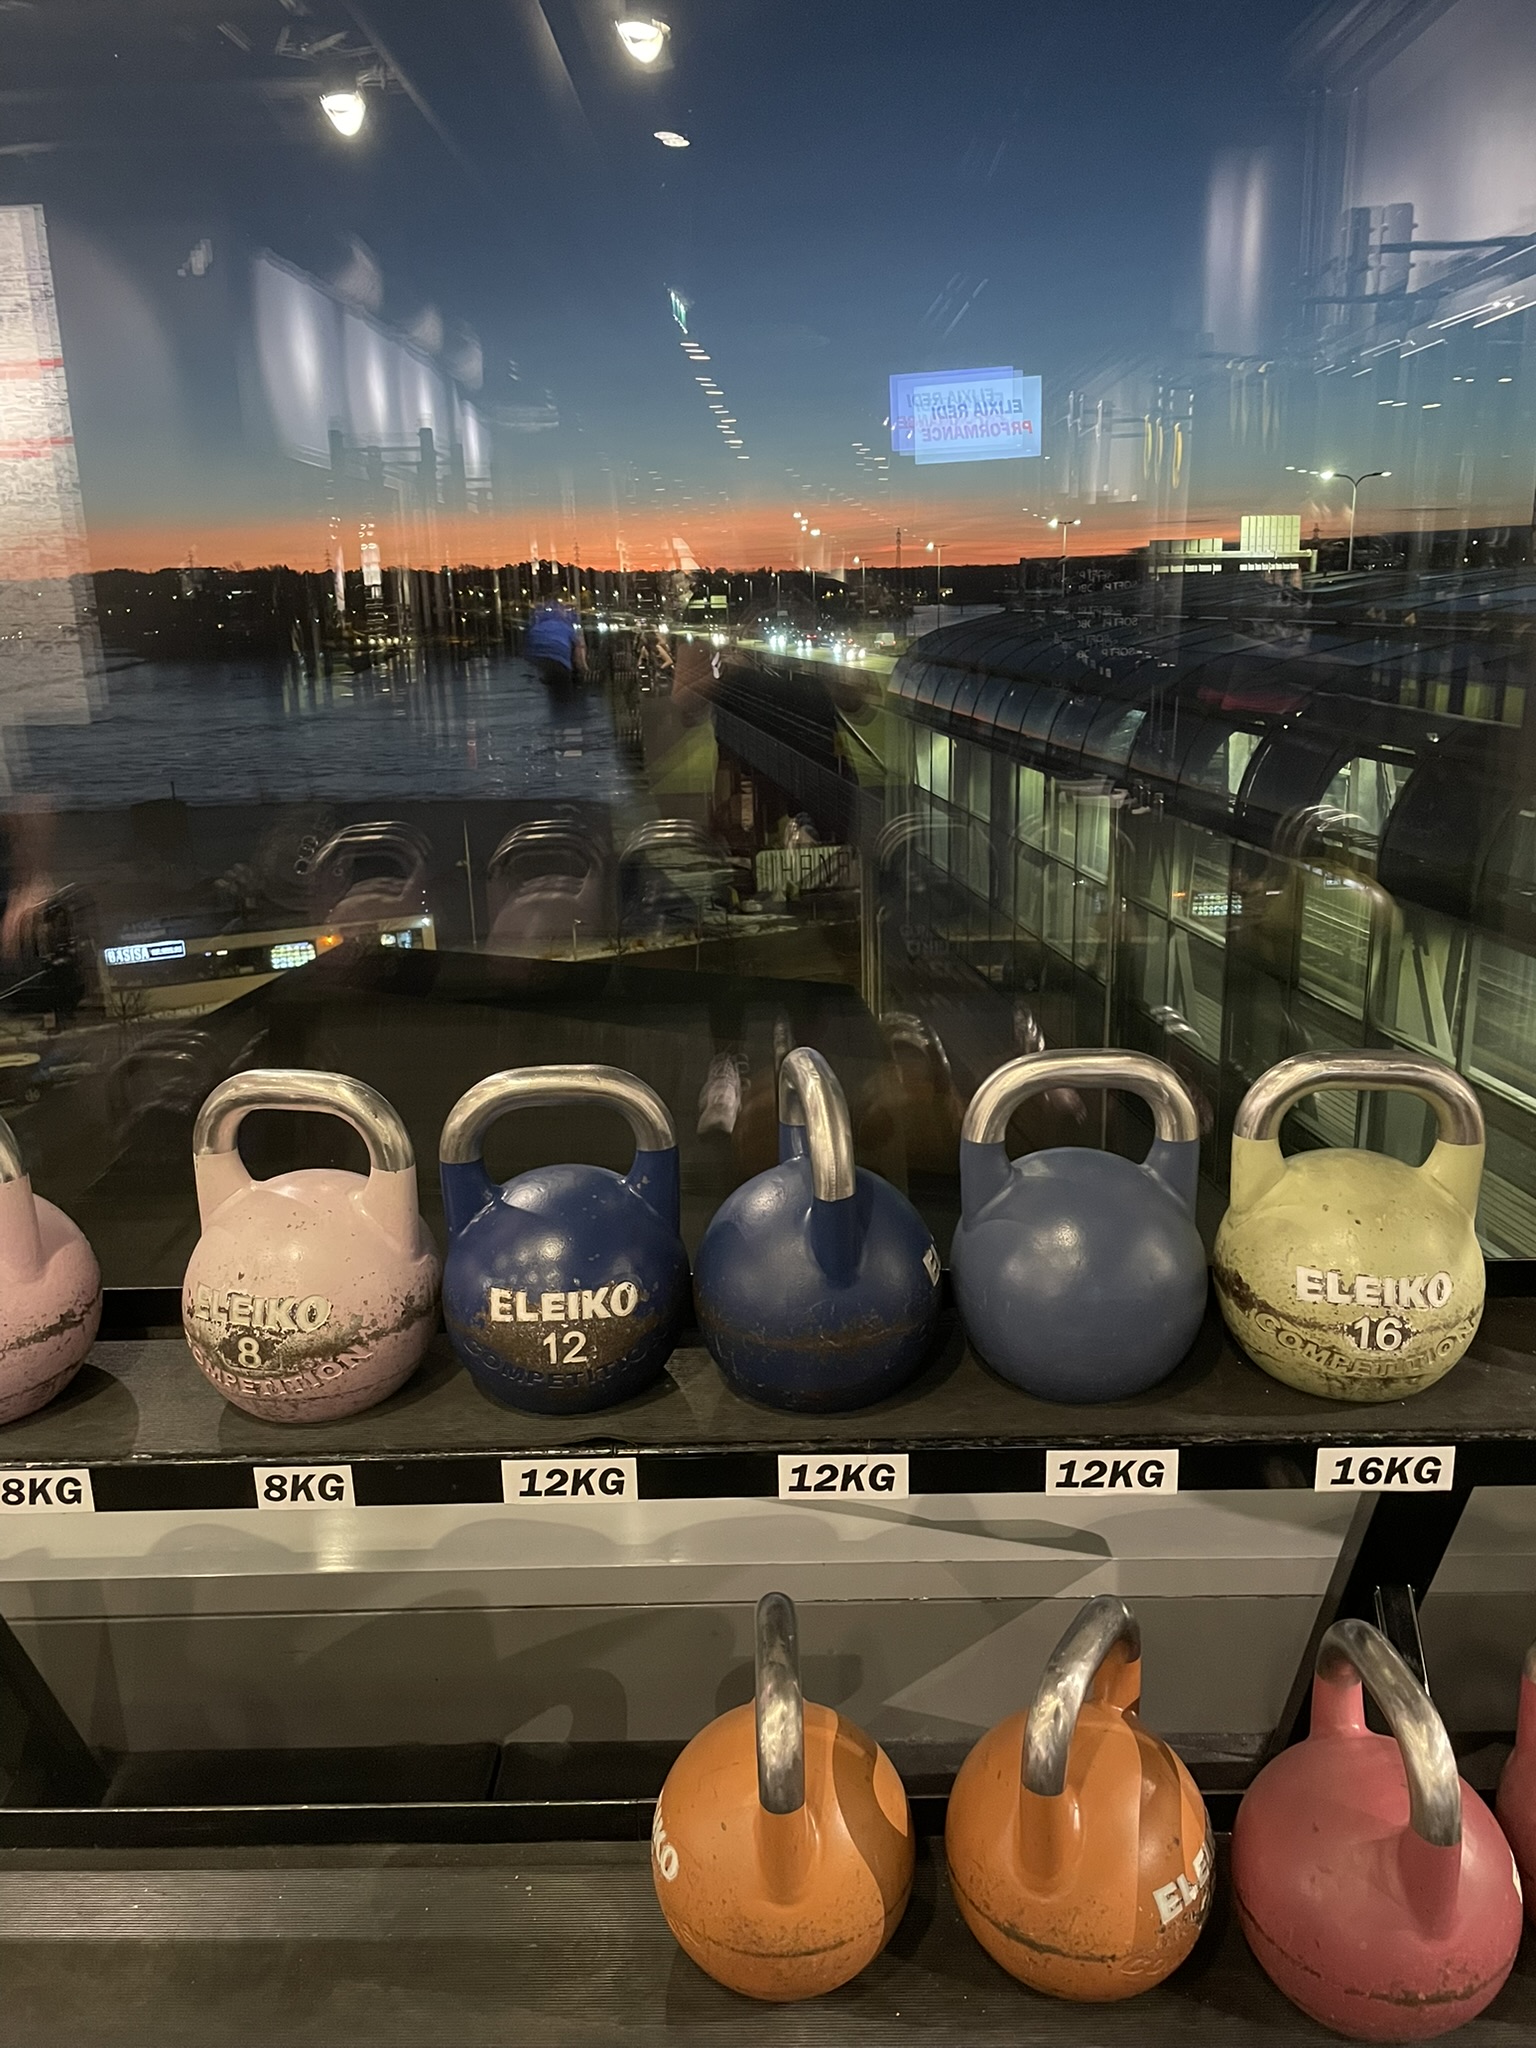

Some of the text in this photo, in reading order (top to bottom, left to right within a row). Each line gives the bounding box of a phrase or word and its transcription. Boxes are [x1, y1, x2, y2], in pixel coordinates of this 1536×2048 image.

[490, 1280, 639, 1323] ELEIKO
[1295, 1265, 1454, 1309] ELEIKO
[195, 1282, 333, 1333] ELEIKO
[543, 1330, 588, 1365] 12
[1353, 1315, 1403, 1351] 16
[237, 1336, 262, 1369] 8
[518, 1467, 626, 1497] 12KG
[788, 1463, 896, 1492] 12KG
[1055, 1459, 1166, 1488] 12KG
[1330, 1456, 1442, 1485] 16KG
[1, 1476, 83, 1506] 8KG
[263, 1473, 346, 1502] 8KG
[1152, 1833, 1213, 1925] ELE
